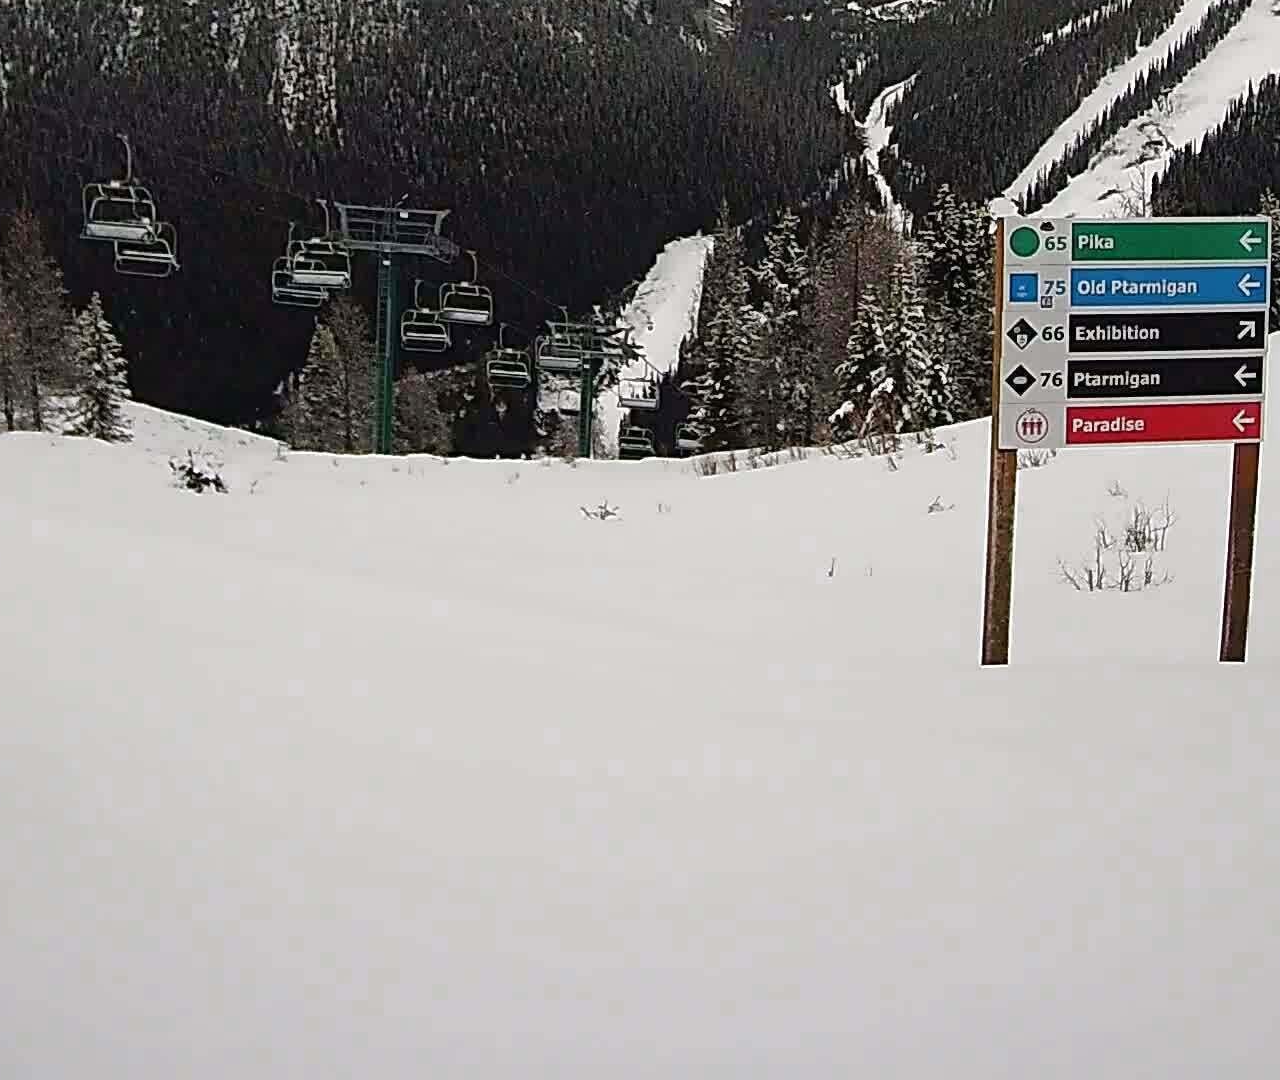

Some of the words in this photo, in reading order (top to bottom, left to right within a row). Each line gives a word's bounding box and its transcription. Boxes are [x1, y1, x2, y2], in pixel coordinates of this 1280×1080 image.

[1044, 235, 1067, 251] 65
[1078, 234, 1114, 249] Pika
[1043, 280, 1066, 296] 75
[1077, 279, 1106, 295] Old
[1111, 279, 1197, 297] Ptarmigan
[1041, 326, 1065, 342] 66
[1075, 325, 1160, 341] Exhibition
[1040, 371, 1063, 388] 76
[1073, 371, 1161, 389] Ptarmigan
[1072, 417, 1145, 433] Paradise
